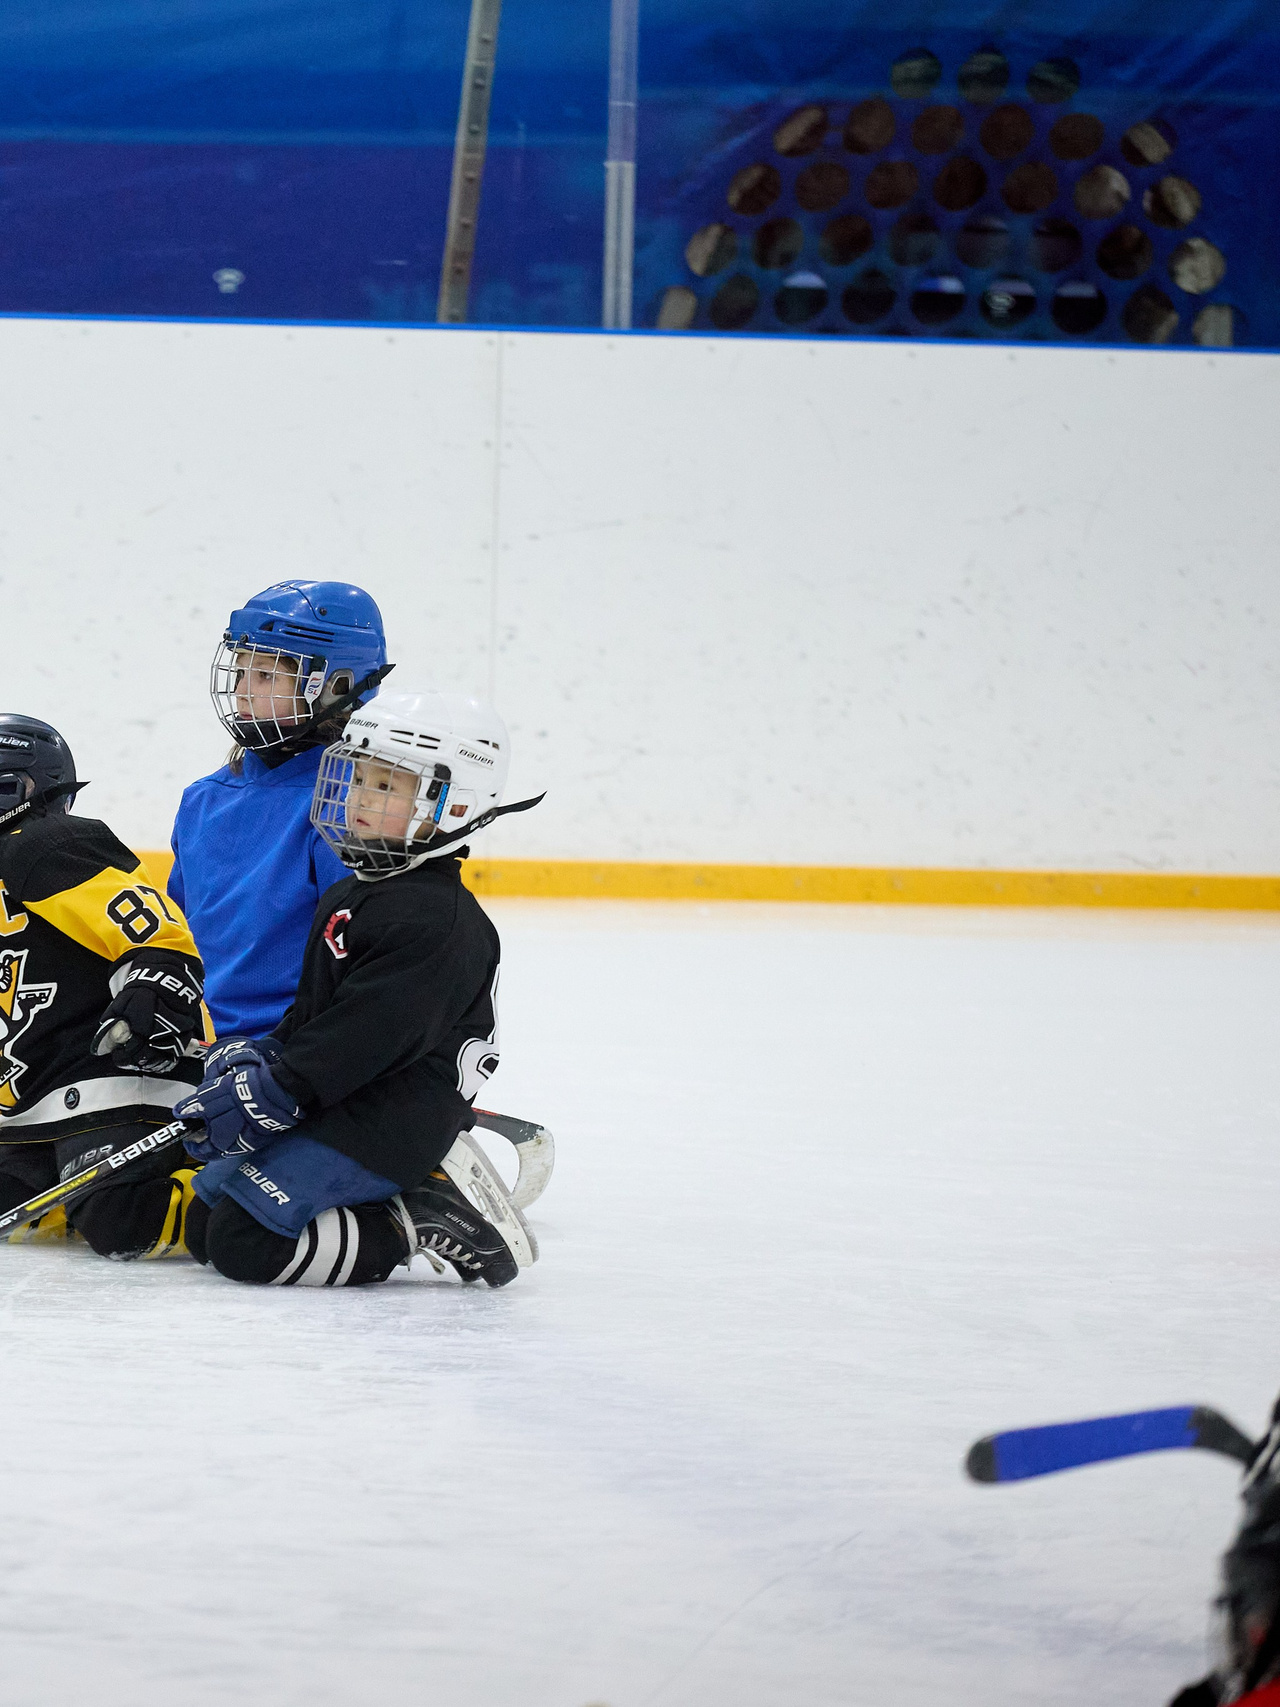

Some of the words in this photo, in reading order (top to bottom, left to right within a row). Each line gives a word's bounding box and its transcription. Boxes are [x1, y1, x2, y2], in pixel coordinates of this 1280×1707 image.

[349, 718, 379, 730] BAUER
[458, 749, 494, 766] BAUER
[105, 884, 181, 946] 87
[235, 1070, 292, 1132] BAUER
[107, 1119, 187, 1169] BAUER
[238, 1162, 291, 1206] BAUER
